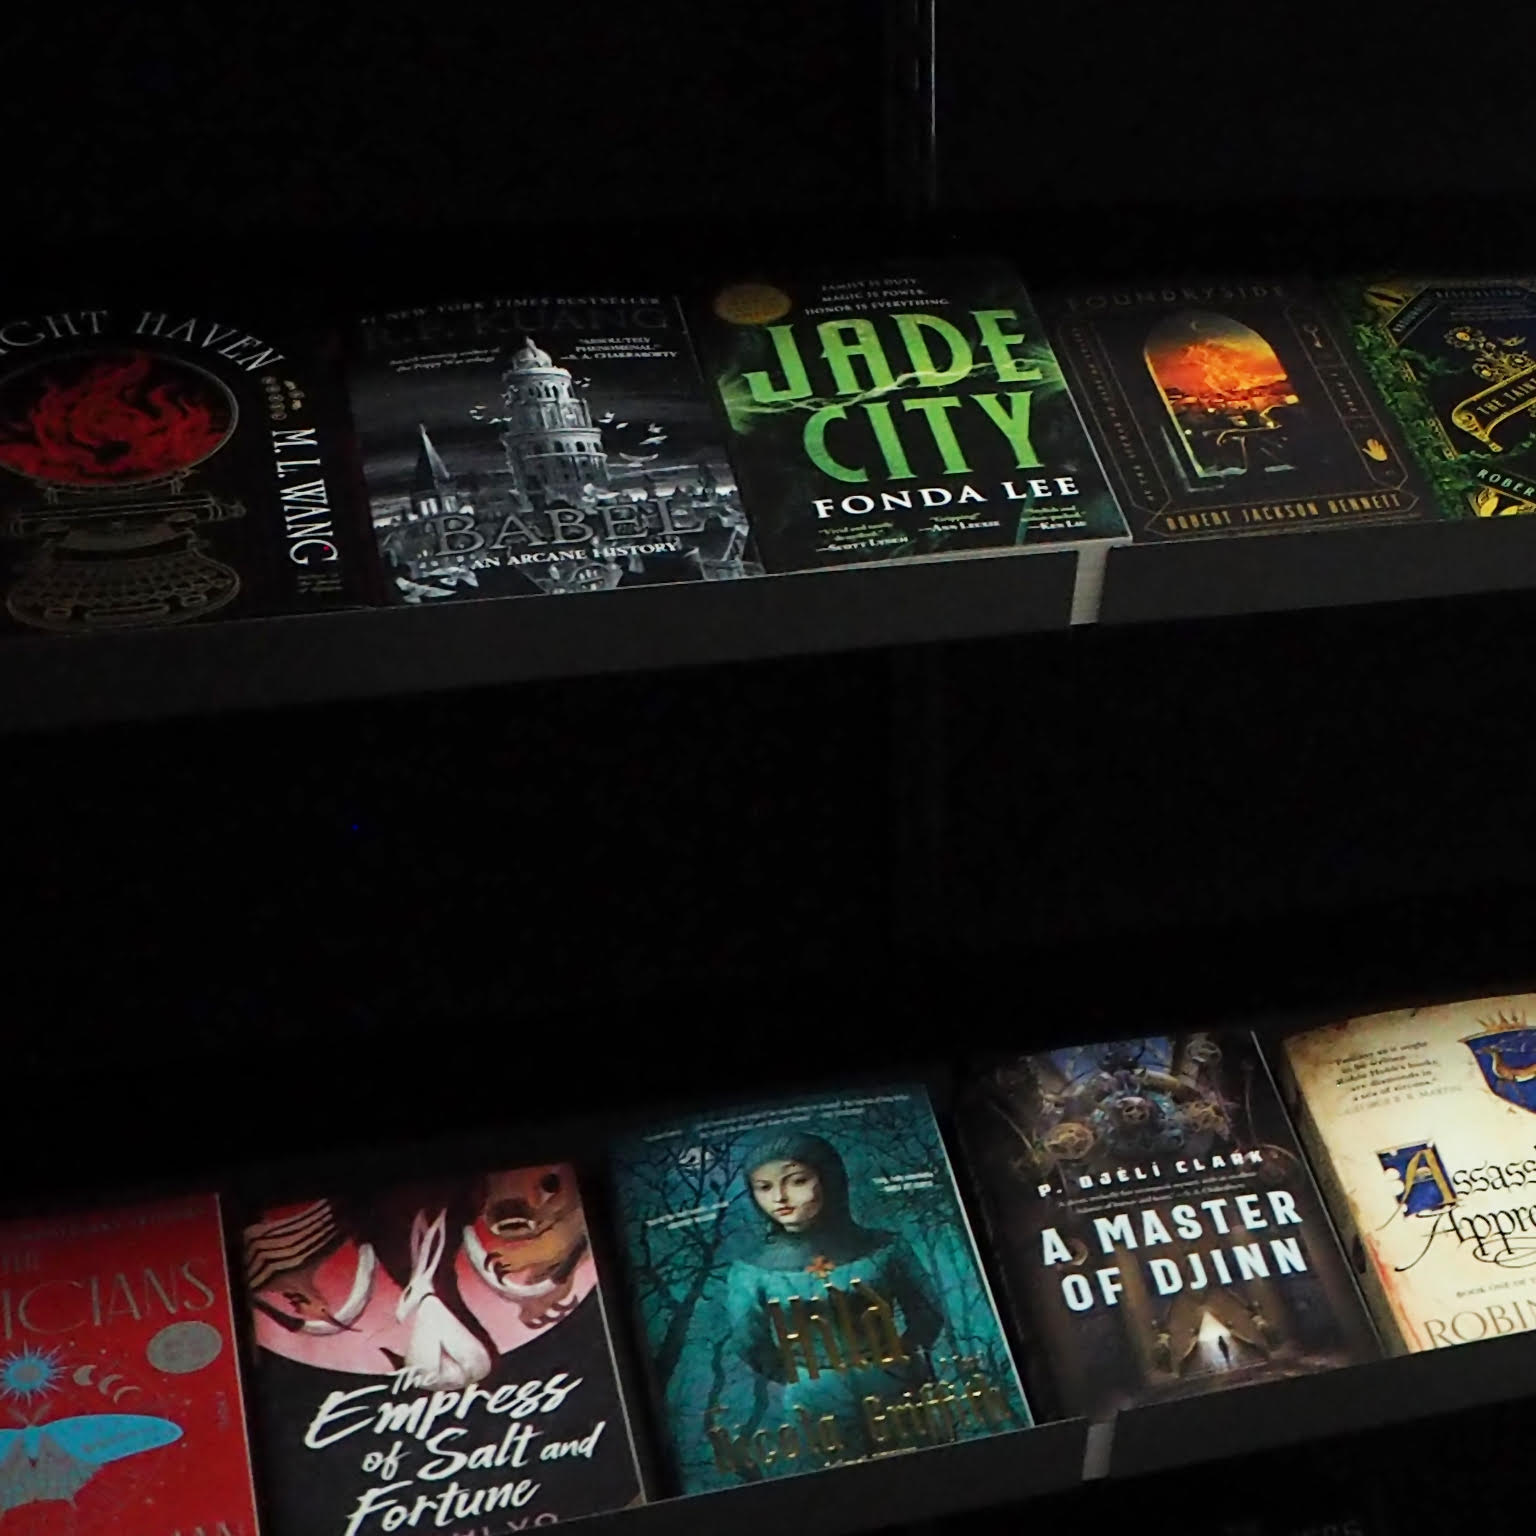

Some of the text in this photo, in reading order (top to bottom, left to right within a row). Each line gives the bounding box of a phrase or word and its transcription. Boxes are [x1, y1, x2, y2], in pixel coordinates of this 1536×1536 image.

[135, 310, 287, 375] HAVEN
[742, 308, 1043, 403] JADE
[1476, 391, 1506, 416] THE
[802, 390, 1047, 484] CITY
[279, 478, 340, 568] WANG
[436, 498, 707, 556] BABEL
[811, 478, 1080, 520] FONDA LEE
[505, 541, 682, 568] ARCANE HISTORY
[1092, 1190, 1303, 1254] MASTER
[1061, 1235, 1308, 1314] OF DJINN
[304, 1370, 583, 1449] Empress
[362, 1421, 606, 1482] of Salt and
[345, 1477, 542, 1536] Fortune
